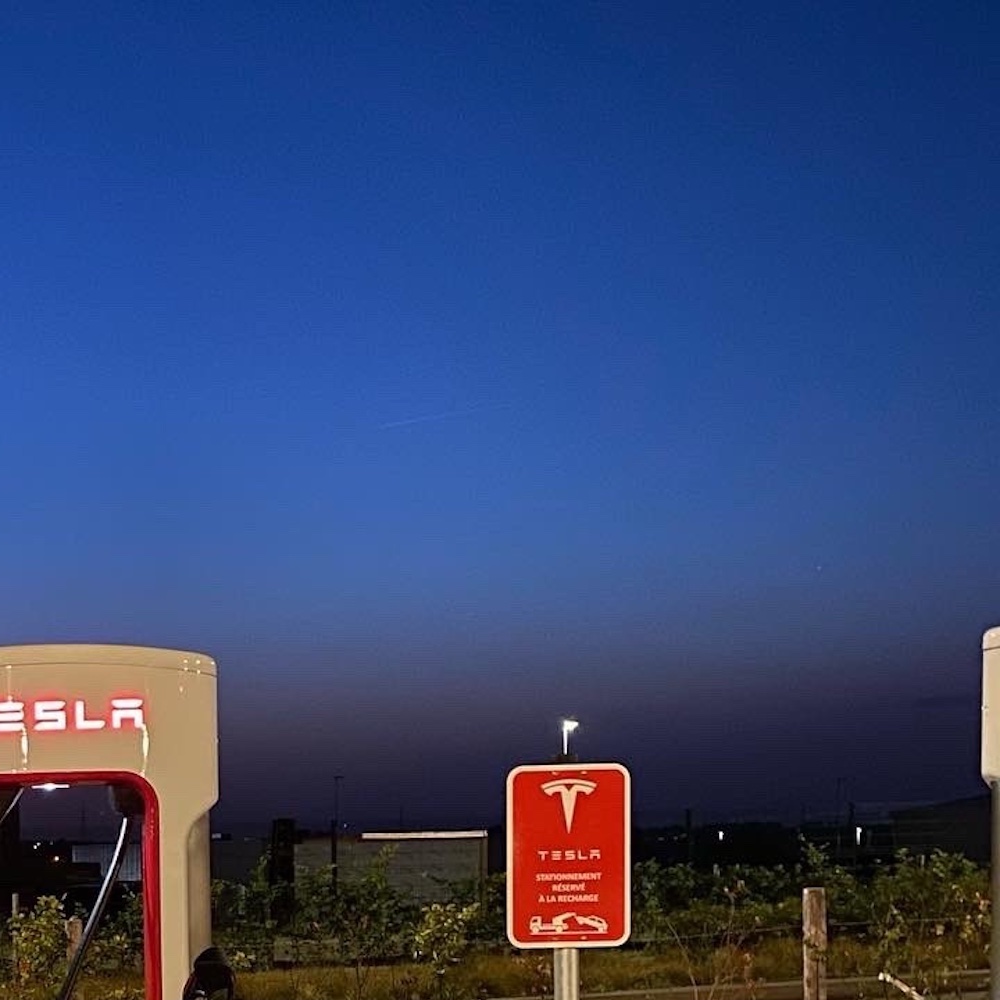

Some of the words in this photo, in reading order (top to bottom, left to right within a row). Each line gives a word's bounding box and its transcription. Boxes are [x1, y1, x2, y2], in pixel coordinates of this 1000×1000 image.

[537, 849, 601, 861] TESLA
[535, 872, 602, 882] STATIONNEMENT
[546, 894, 557, 903] LA
[557, 893, 599, 903] RECHARGE
